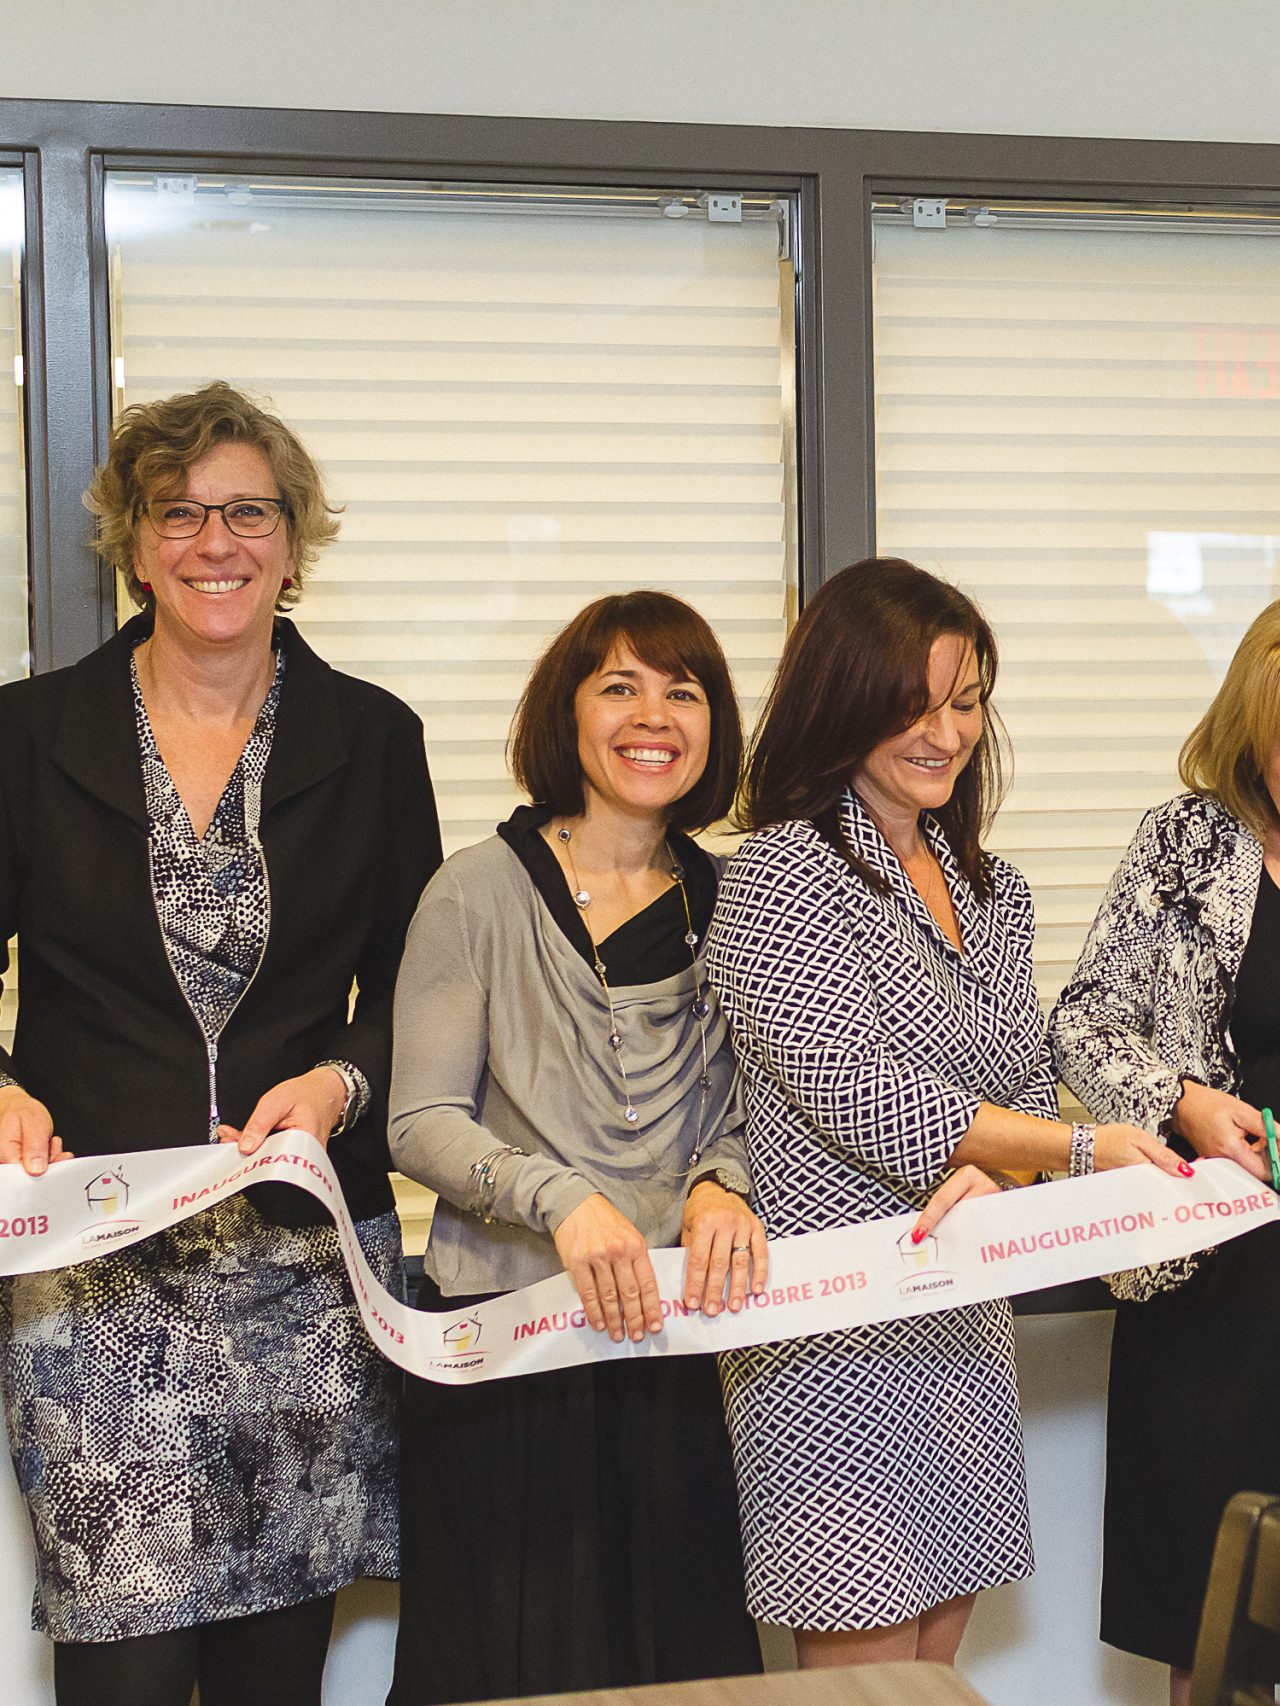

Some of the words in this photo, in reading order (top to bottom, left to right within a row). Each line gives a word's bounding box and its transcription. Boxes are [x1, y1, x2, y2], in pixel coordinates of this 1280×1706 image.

[172, 1154, 333, 1210] INAUGURATION
[0, 1215, 49, 1238] 2013
[980, 1211, 1156, 1264] INAUGURATION
[1174, 1191, 1274, 1223] OCTOBRE
[513, 1299, 690, 1341] INAUGON
[744, 1282, 814, 1310] TOBRE
[818, 1271, 868, 1297] 2013
